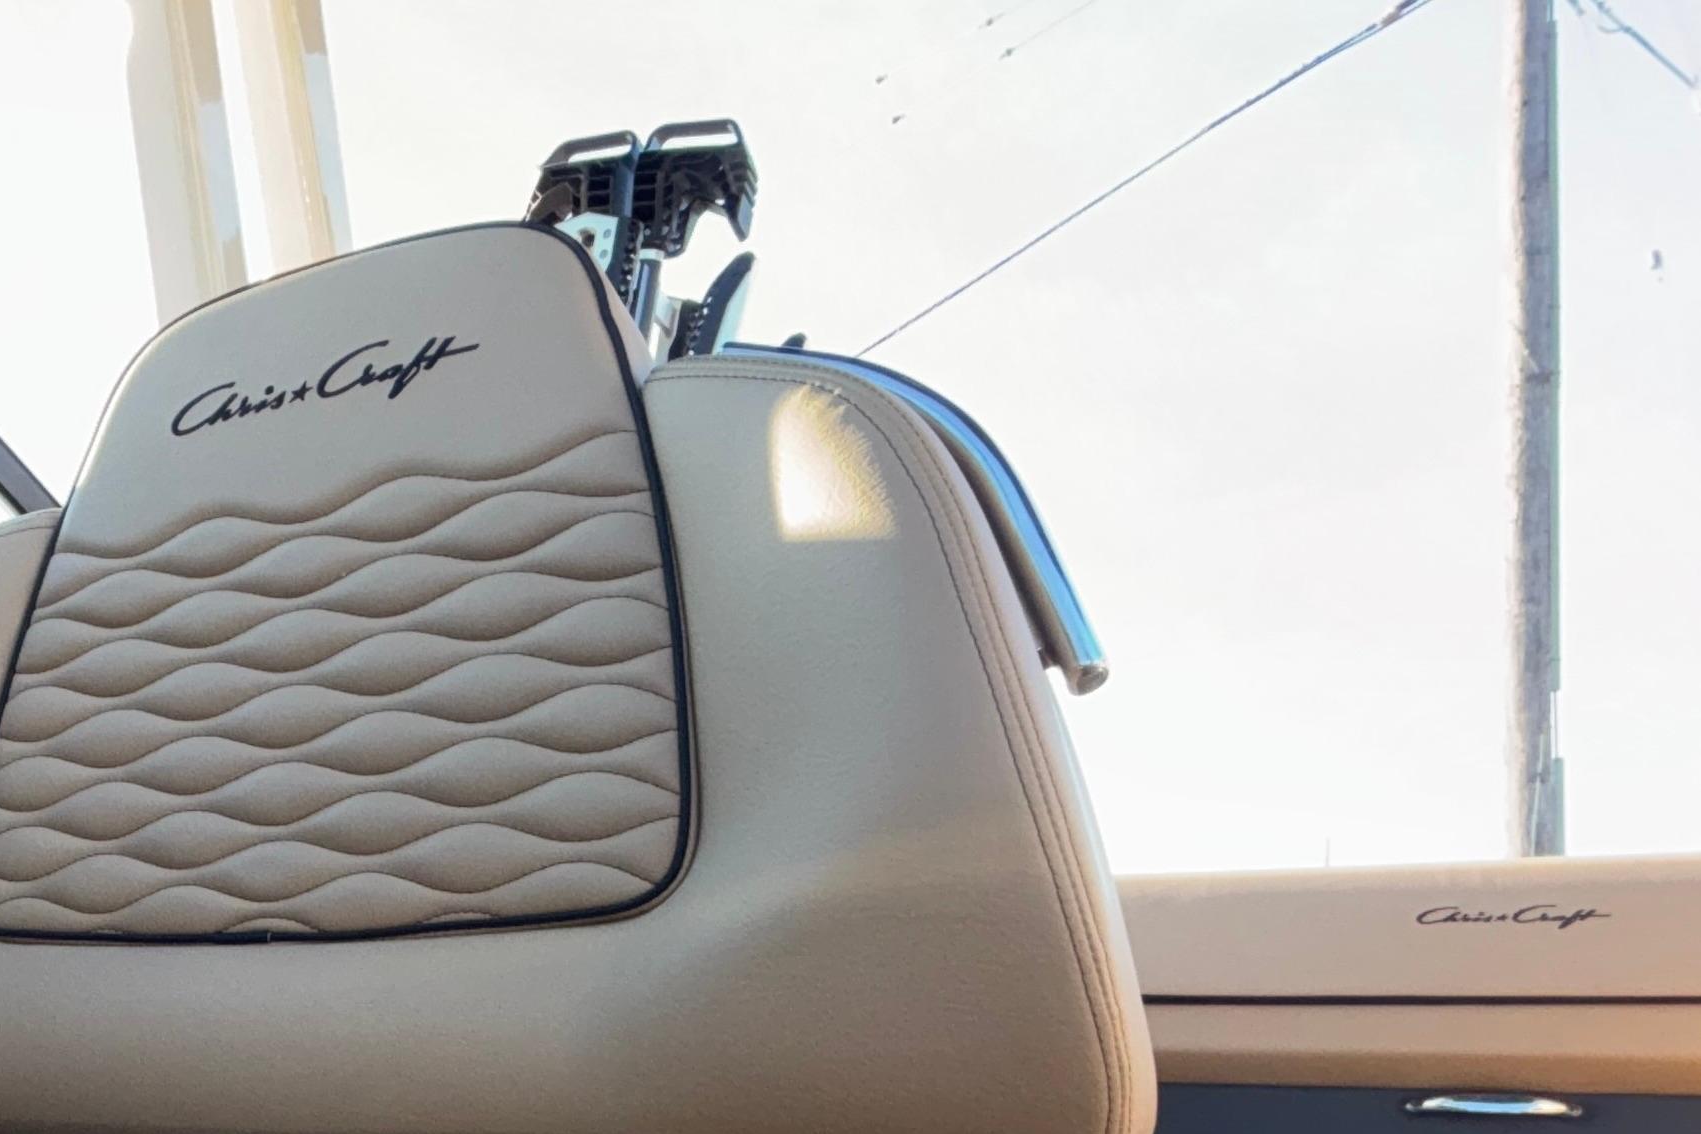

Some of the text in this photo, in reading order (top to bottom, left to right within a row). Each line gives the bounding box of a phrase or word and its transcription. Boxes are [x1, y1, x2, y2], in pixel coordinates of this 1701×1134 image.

[171, 336, 480, 437] Chris Craft
[1416, 904, 1612, 929] Chris Craft
